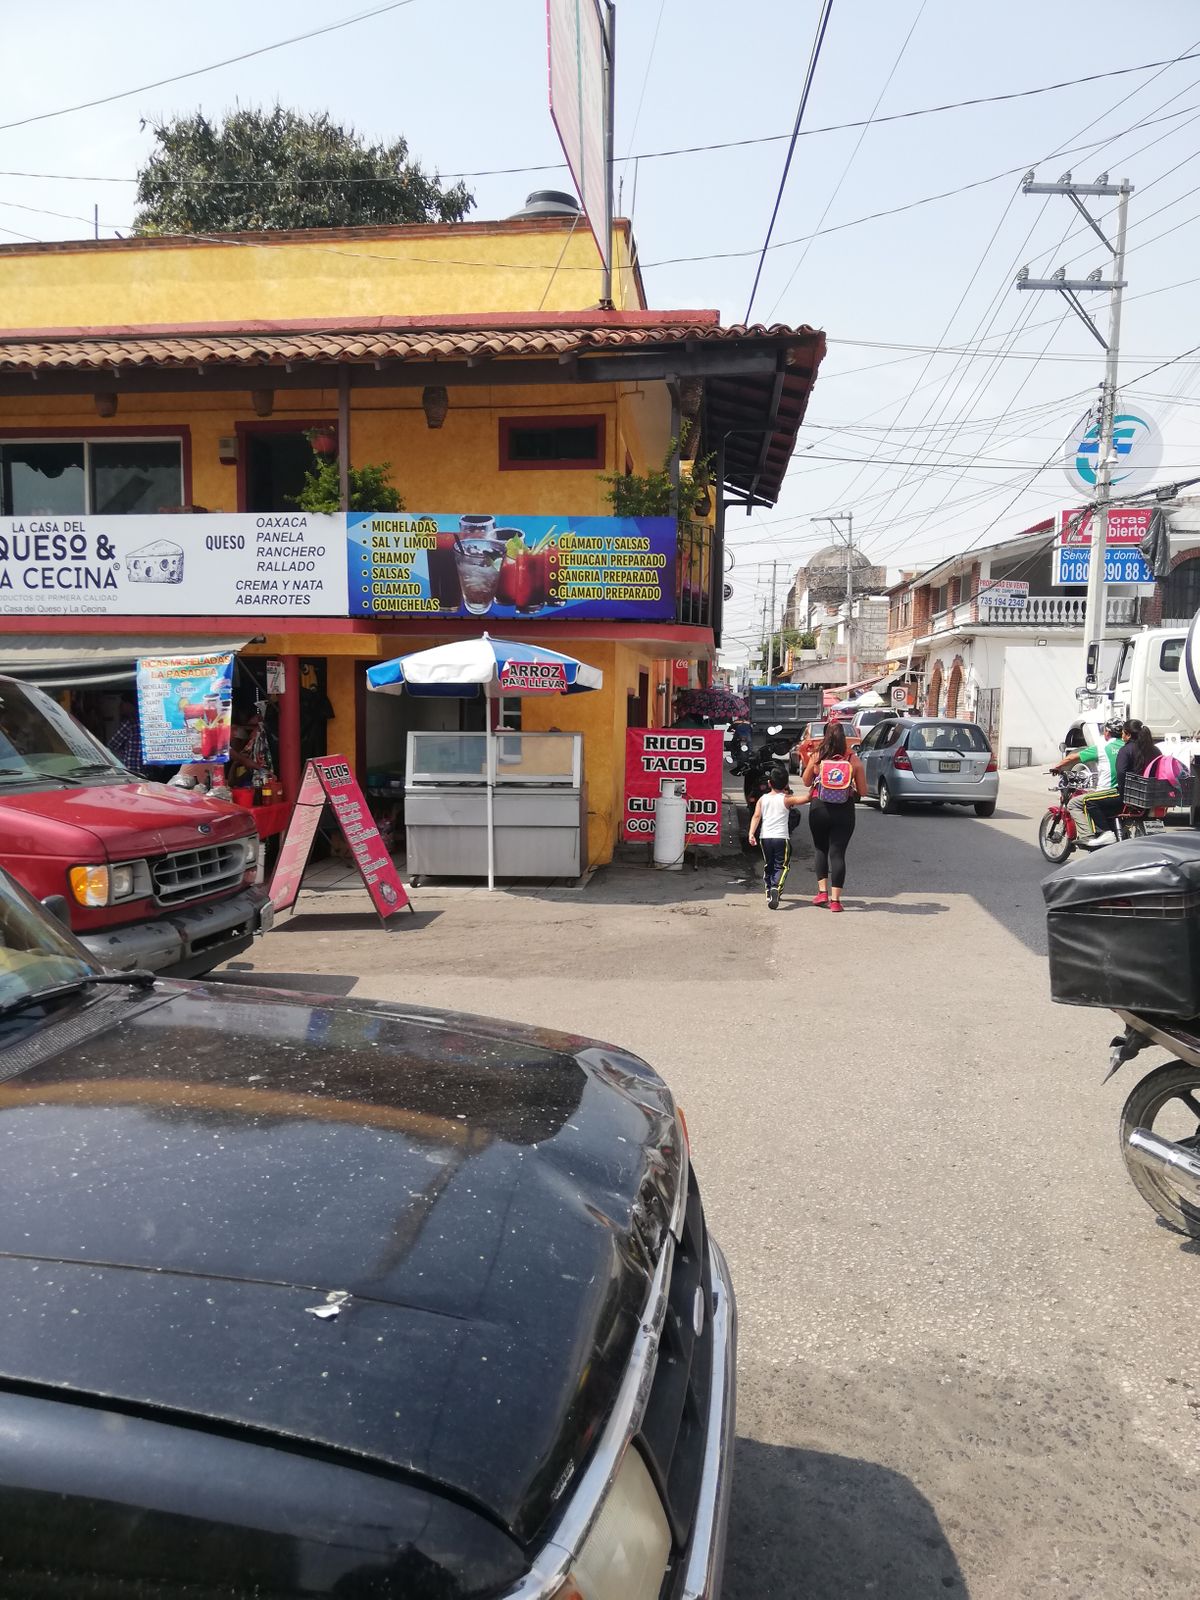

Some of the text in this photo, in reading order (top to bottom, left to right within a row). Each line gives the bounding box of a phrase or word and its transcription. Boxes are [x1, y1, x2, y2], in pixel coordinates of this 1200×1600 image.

[256, 517, 308, 528] OAXACA
[371, 520, 438, 533] MICHELADAS
[1107, 516, 1146, 524] oras
[12, 521, 85, 533] LA CASA DEL
[1106, 524, 1147, 537] bierto
[205, 535, 246, 551] QUESO
[256, 532, 305, 543] PANELA
[371, 536, 436, 549] SAL Y LIMON
[559, 537, 649, 550] CLAMATO Y SALSAS
[96, 534, 116, 561] &
[256, 546, 326, 557] RANCHERO
[372, 552, 416, 564] CHAMOY
[559, 554, 665, 567] TEHUACAN PREPARADO
[256, 561, 315, 572] RALLADO
[1062, 562, 1089, 581] 0180
[1125, 562, 1139, 580] 88
[1143, 562, 1155, 581] 3
[0, 566, 118, 589] A CECINA
[371, 567, 410, 580] SALSAS
[559, 570, 658, 583] SANGRIA PREPARADA
[235, 580, 324, 591] CREMA Y NATA
[372, 583, 421, 595] CLAMATO
[235, 594, 311, 605] ABARROTES
[559, 586, 660, 600] CLAMATO PREPARADO
[373, 598, 439, 611] GOMICHELAS
[142, 655, 230, 668] RICAS MICHELADAS
[151, 670, 164, 679] LA
[509, 664, 560, 678] ARROZ
[529, 678, 565, 689] LLEVAR
[644, 736, 704, 752] RICOS
[642, 757, 706, 772] TACOS
[628, 798, 717, 815] GUDO
[686, 821, 717, 835] ROZ
